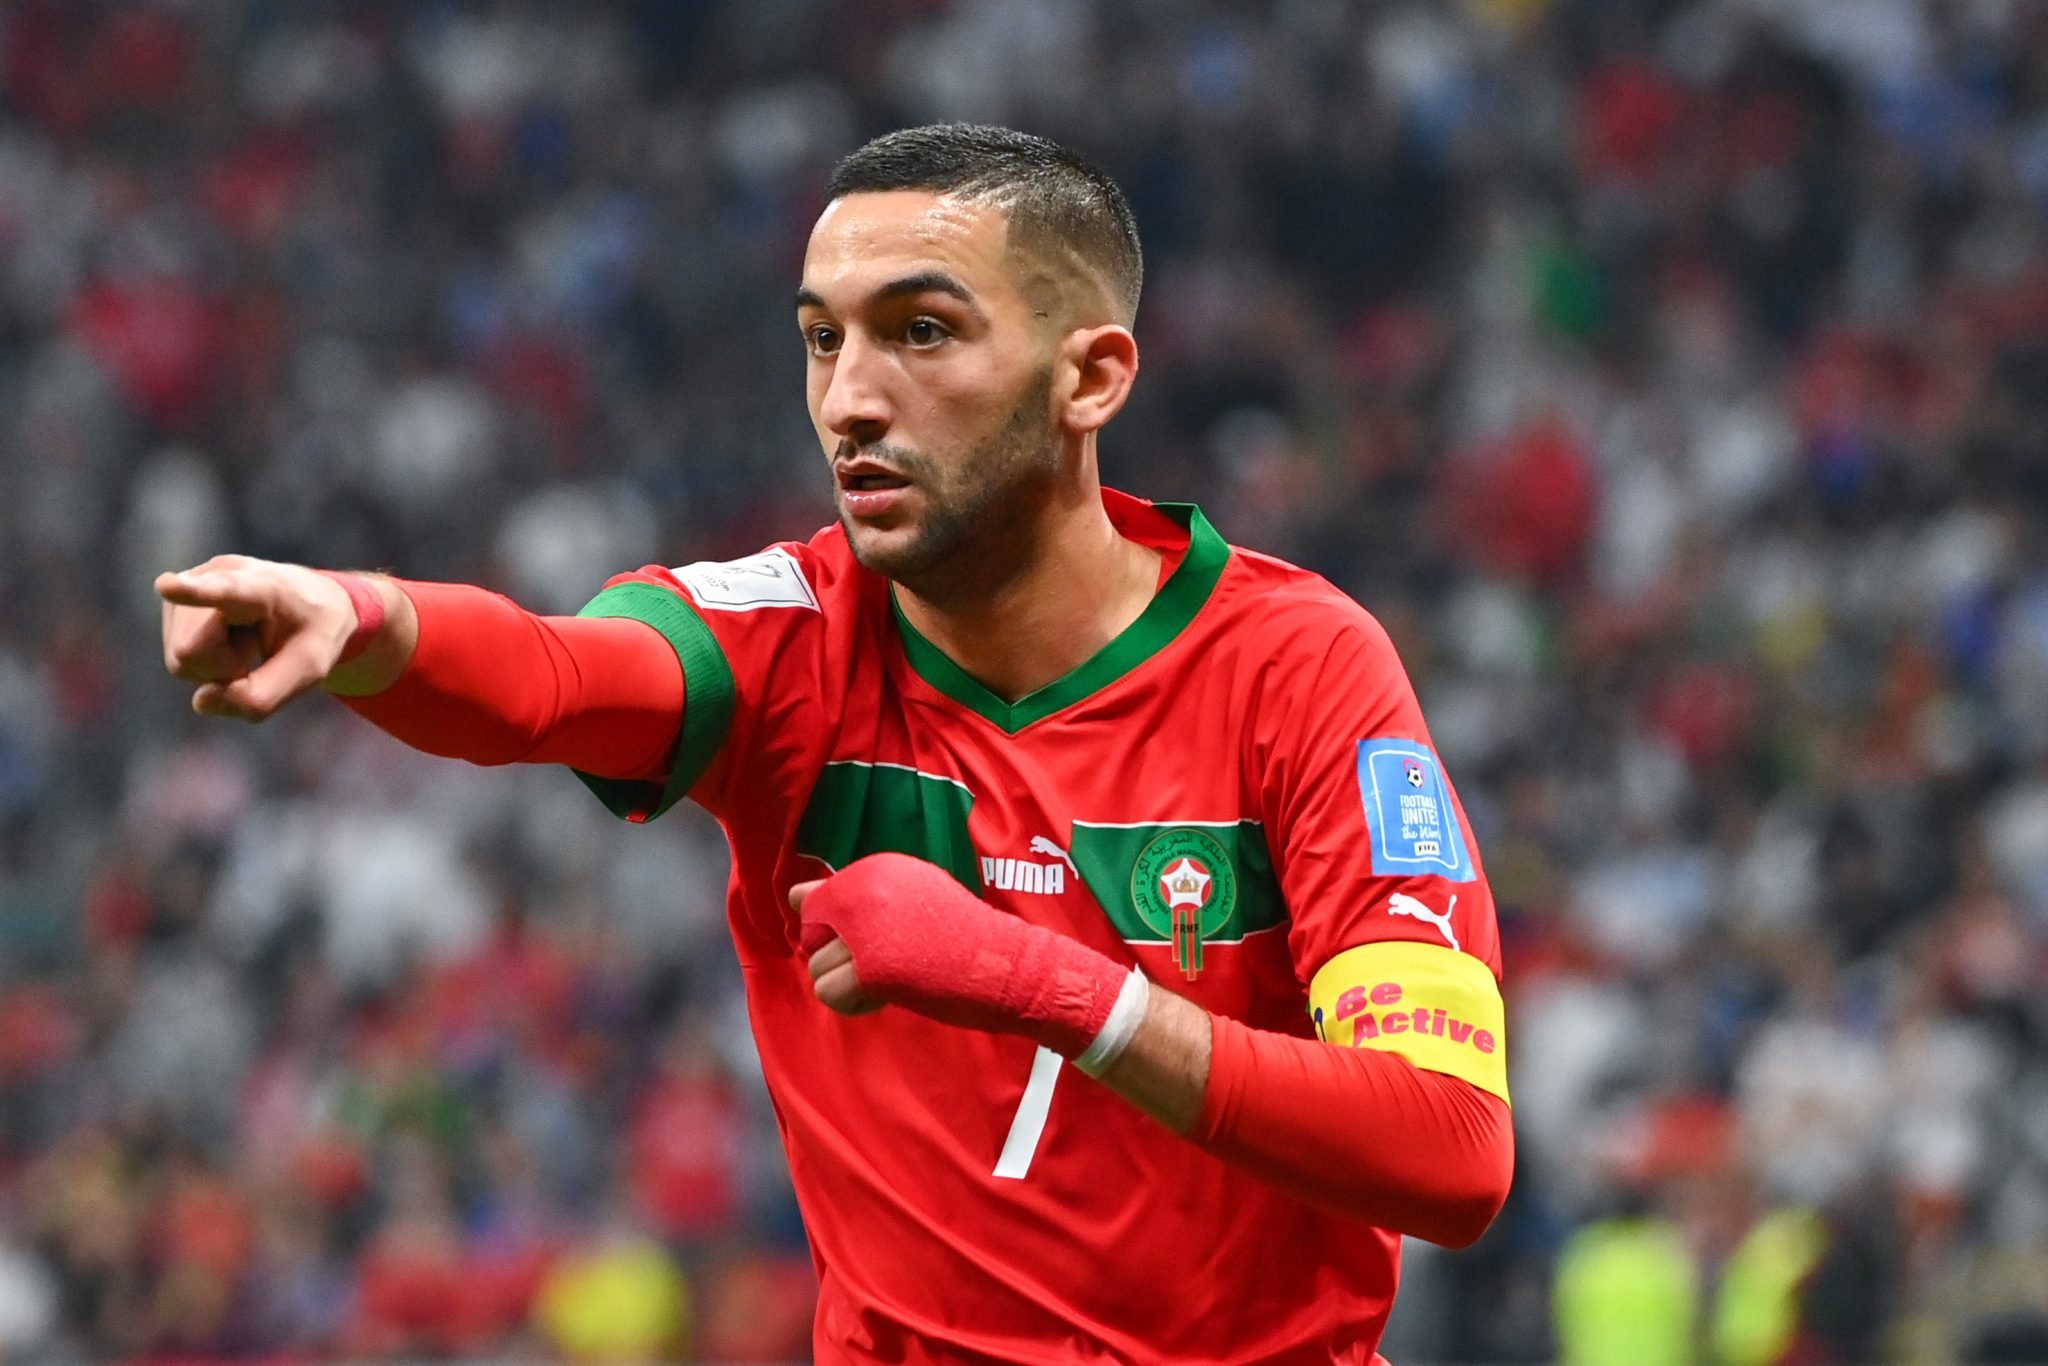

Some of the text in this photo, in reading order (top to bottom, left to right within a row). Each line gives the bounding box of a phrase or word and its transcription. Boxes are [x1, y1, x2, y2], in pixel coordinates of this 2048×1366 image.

[1401, 825, 1418, 840] the
[1418, 844, 1438, 853] FIFA
[981, 856, 1064, 894] PUMA
[1173, 923, 1200, 934] FRMF
[1336, 983, 1403, 1022] Be
[1352, 1007, 1495, 1054] Active
